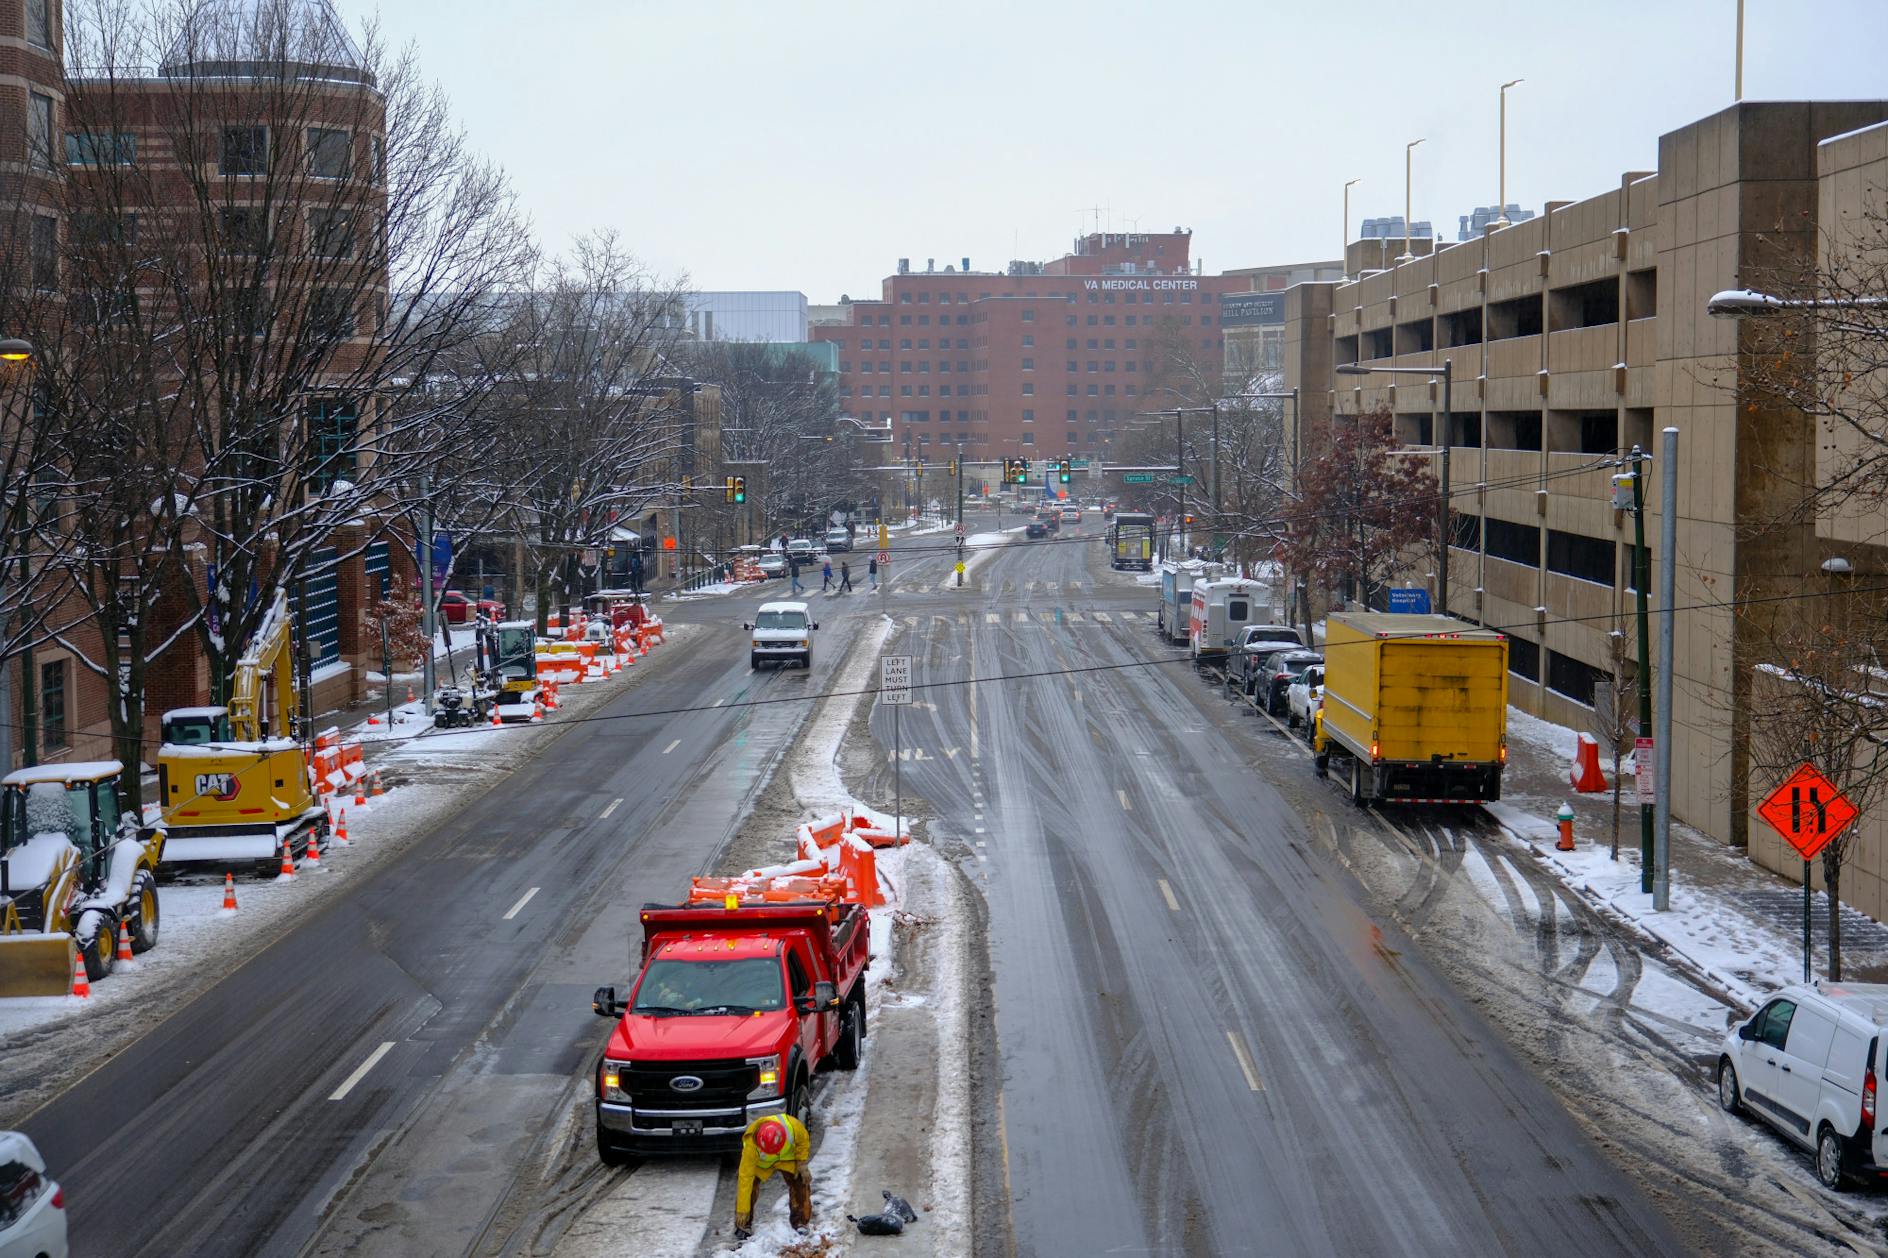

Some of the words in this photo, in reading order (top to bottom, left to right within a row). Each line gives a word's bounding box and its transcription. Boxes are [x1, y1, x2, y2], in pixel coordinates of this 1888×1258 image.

[1084, 280, 1098, 290] VA
[1102, 280, 1150, 290] MEDICAL
[1153, 280, 1198, 290] CENTER
[195, 773, 230, 796] CAT
